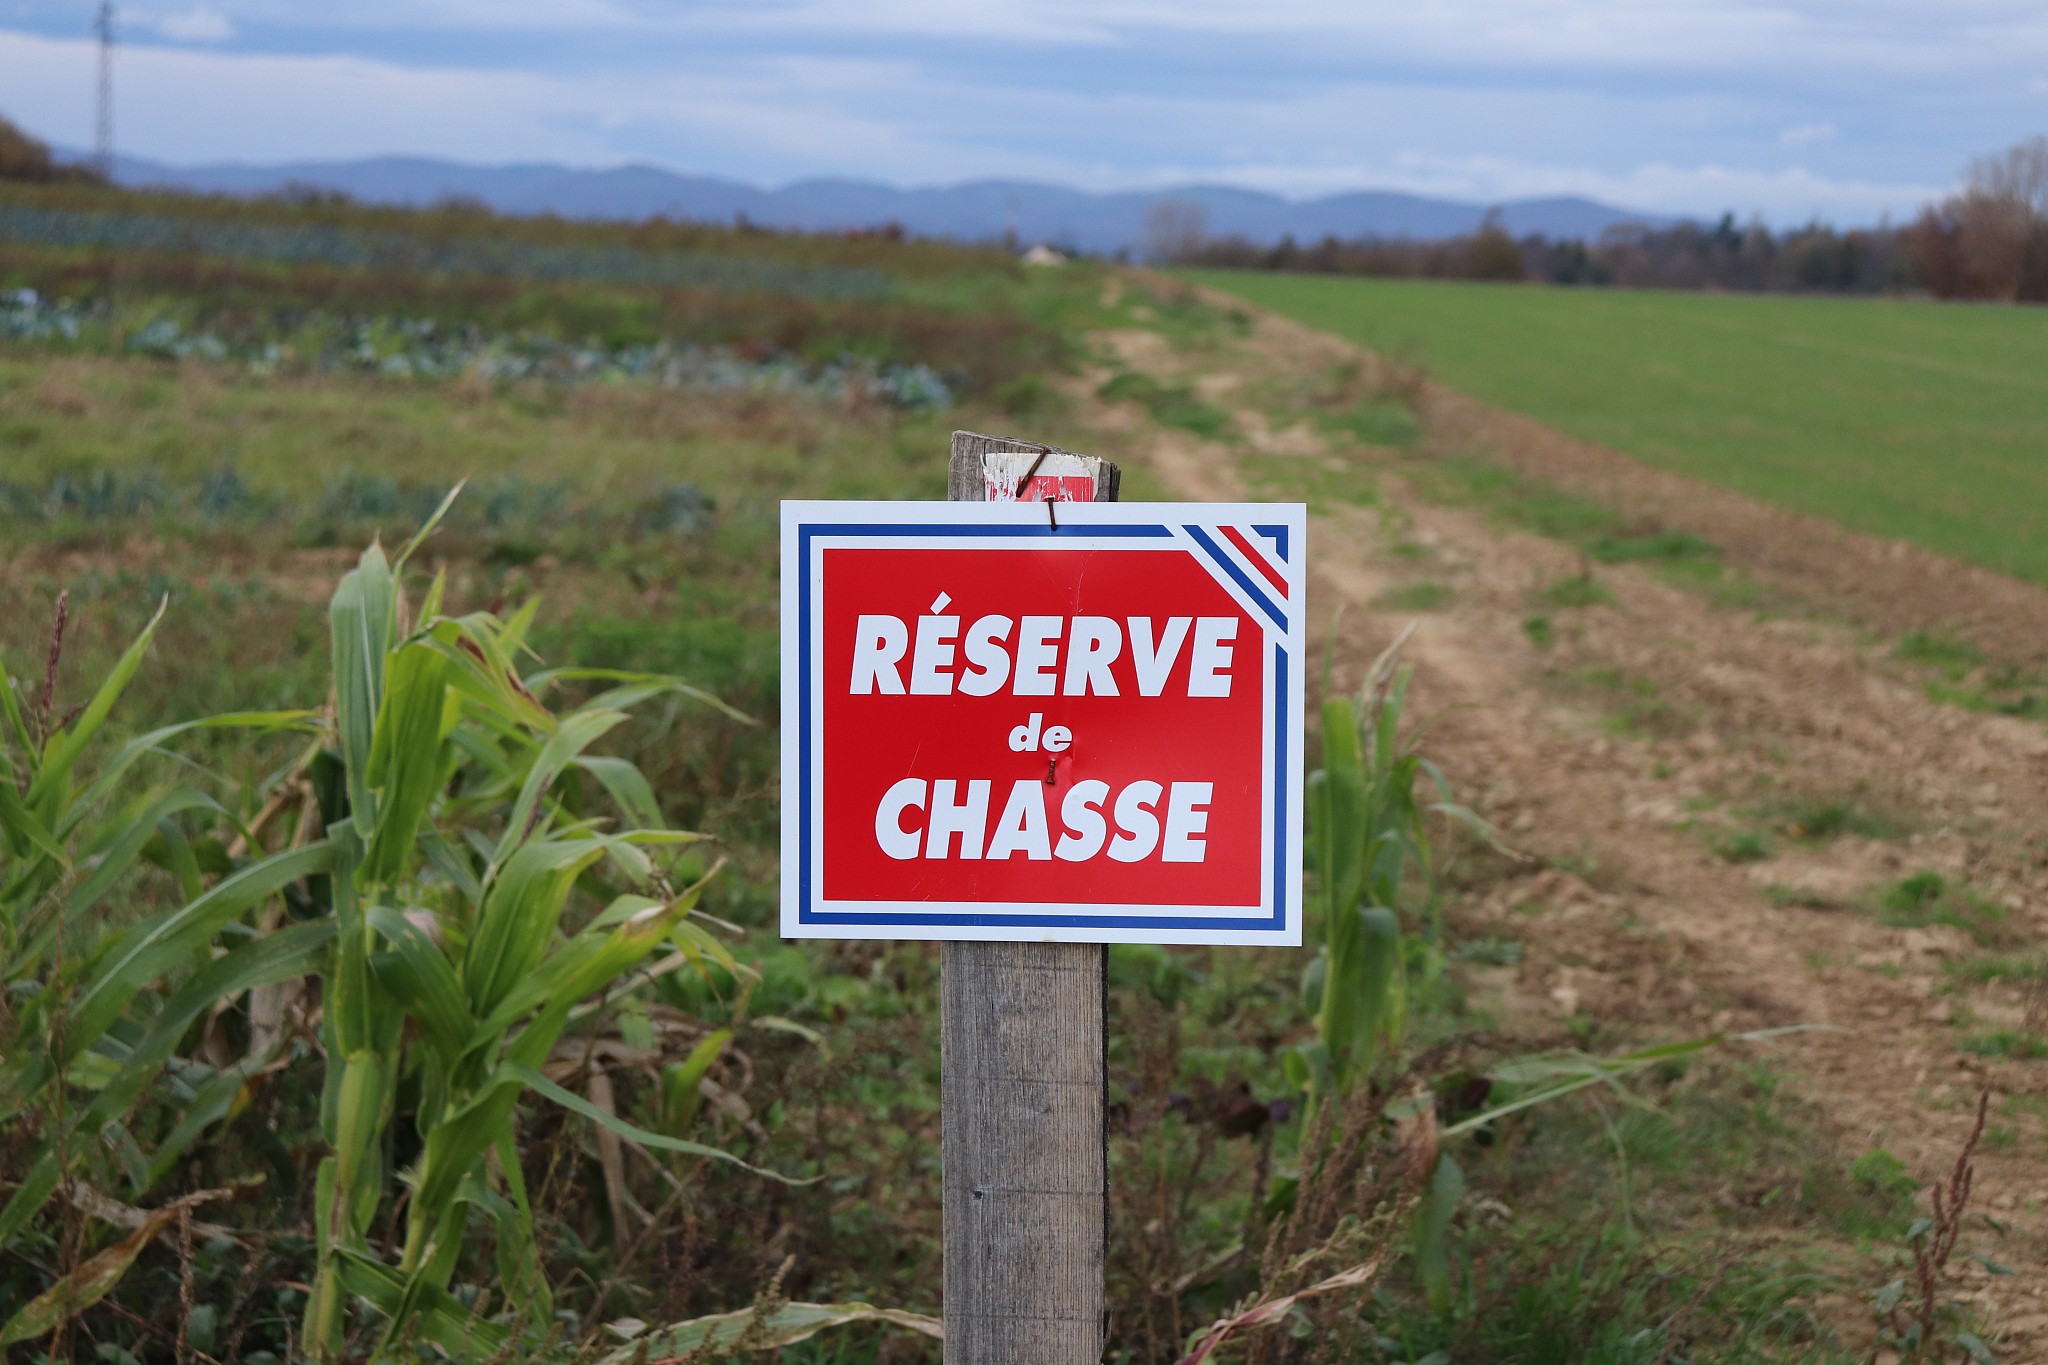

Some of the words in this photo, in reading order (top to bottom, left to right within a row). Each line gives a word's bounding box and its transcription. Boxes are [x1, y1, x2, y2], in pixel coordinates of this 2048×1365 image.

[850, 591, 1239, 698] RÉSERVE
[1009, 713, 1073, 752] de
[875, 778, 1214, 863] CHASSE
